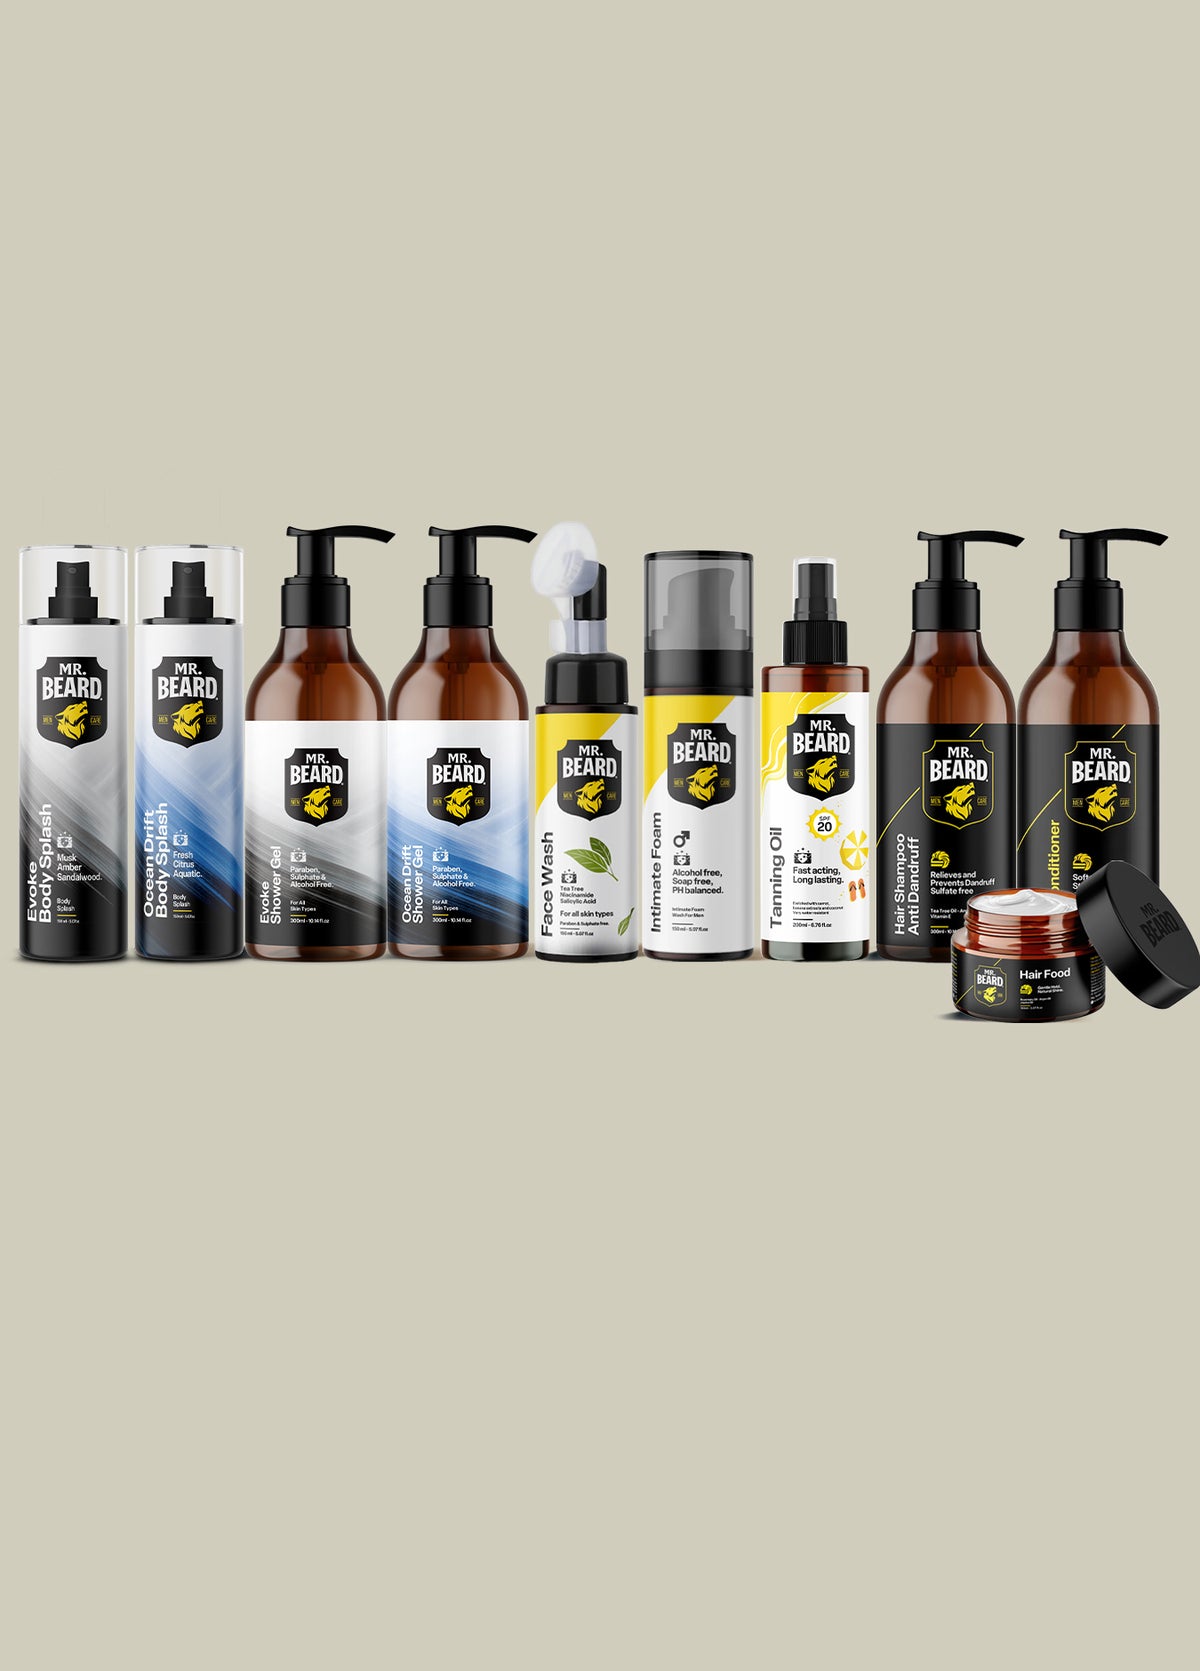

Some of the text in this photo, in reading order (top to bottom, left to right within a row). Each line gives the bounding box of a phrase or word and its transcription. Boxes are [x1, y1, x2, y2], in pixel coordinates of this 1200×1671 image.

[59, 663, 86, 675] MR.
[175, 663, 202, 675] MR.
[810, 720, 836, 731] MR.
[690, 729, 716, 740] MR.
[578, 745, 603, 756] MR.
[948, 746, 974, 758] MR.
[1090, 748, 1116, 759] MR.
[306, 754, 329, 764] MR.
[448, 753, 471, 763] MR.
[817, 822, 832, 832] 20
[156, 803, 170, 918] Body Splash
[173, 851, 193, 859] Fresh
[39, 804, 54, 923] Body Splash
[57, 863, 82, 871] Amber
[144, 809, 154, 917] Ocean Drift
[173, 860, 194, 868] Citrus
[173, 870, 202, 878] Aquatic.
[651, 812, 661, 932] Intimate Foam
[703, 869, 722, 877] free,
[793, 866, 841, 875] Fast acting,
[57, 873, 102, 881] Sandalwood.
[432, 873, 462, 881] Sulphate
[672, 877, 713, 886] Soap free,
[770, 827, 785, 928] Tanning Oil
[793, 876, 844, 885] Long lasting.
[965, 878, 995, 886] Dandruff
[270, 846, 281, 924] Shower Gel
[402, 845, 412, 923] Ocean Drift
[412, 846, 423, 924] Shower Gel
[541, 831, 553, 937] Face Wash
[895, 833, 907, 935] Hair Shampoo
[907, 837, 919, 935] Anti Dandruff
[27, 861, 37, 922] Evoke
[260, 881, 269, 923] Evoke
[57, 905, 75, 913] Splash
[1020, 968, 1071, 979] Hair Food
